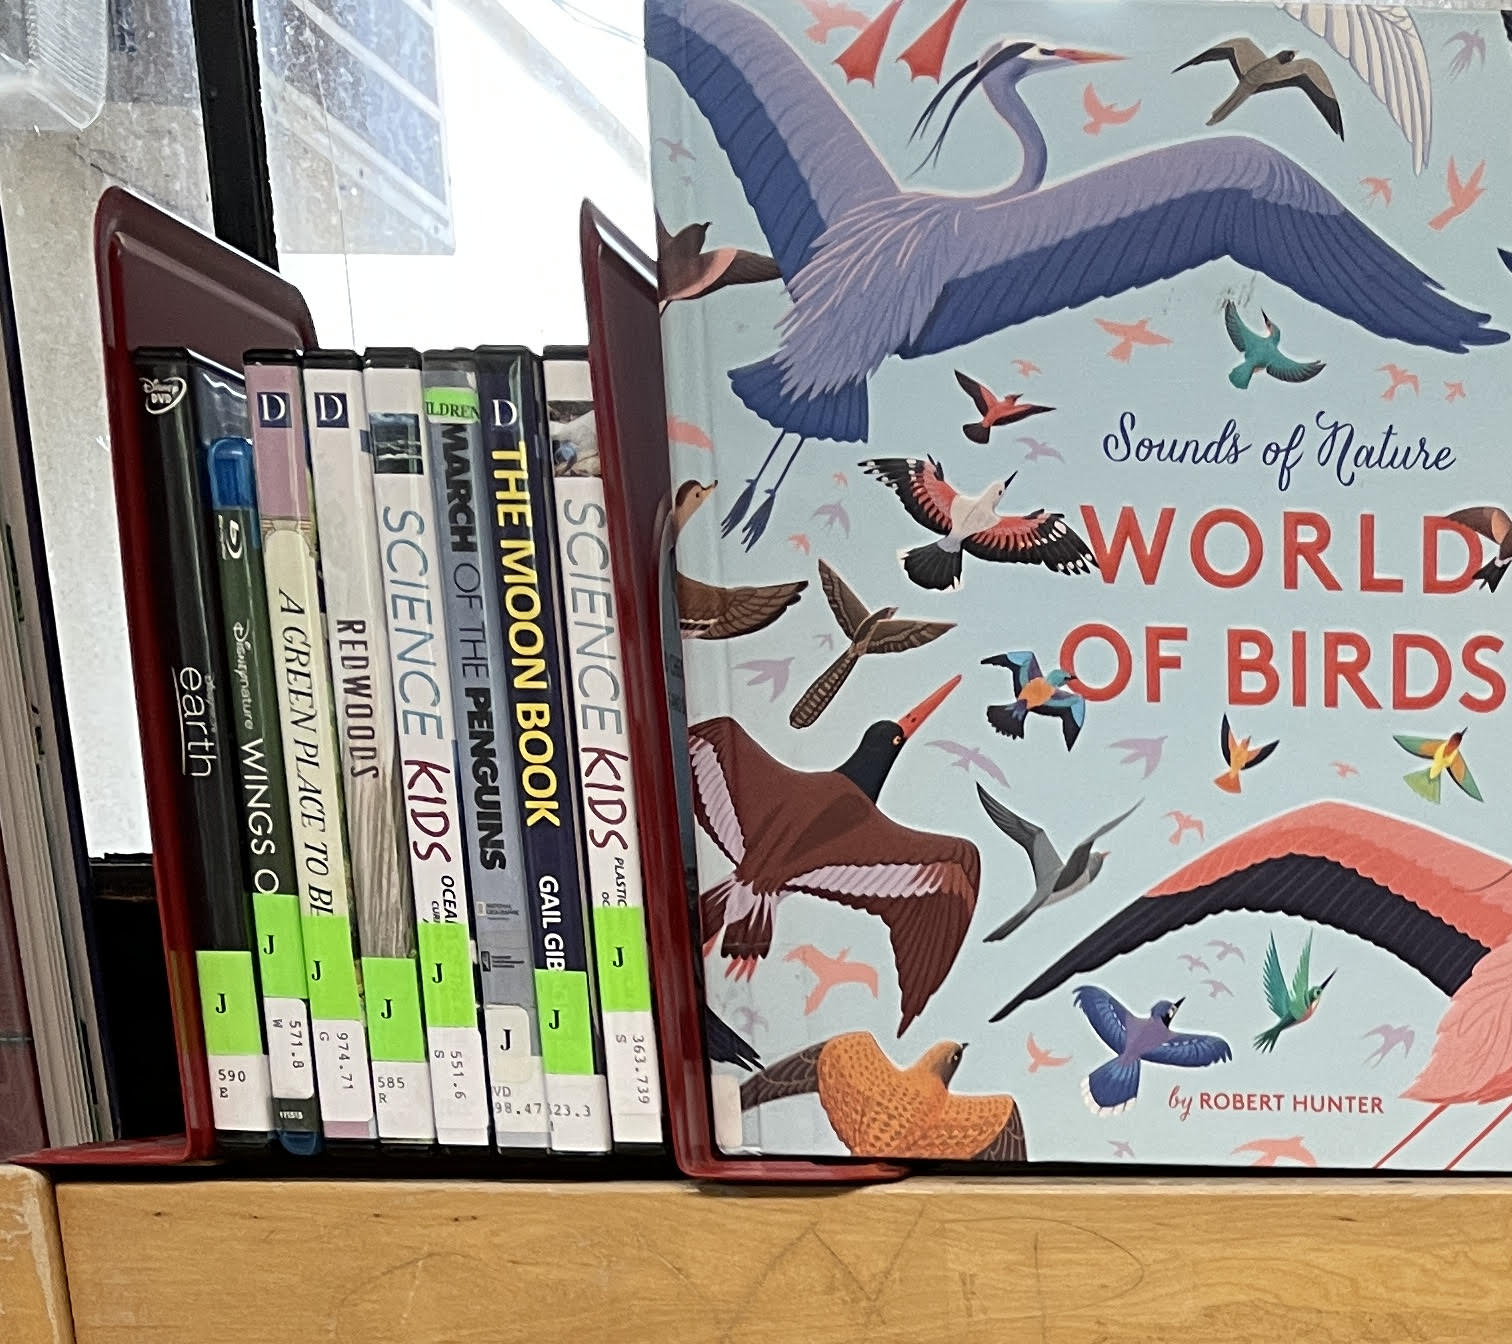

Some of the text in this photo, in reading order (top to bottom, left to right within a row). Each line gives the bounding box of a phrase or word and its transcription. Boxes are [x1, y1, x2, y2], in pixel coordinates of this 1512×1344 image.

[1103, 410, 1456, 492] Sounds of Nature
[1080, 505, 1484, 594] WORLD
[278, 587, 305, 615] A
[492, 440, 560, 827] THE MOON BOOK
[282, 627, 317, 733] GREEN
[336, 619, 379, 778] REDWOODS
[383, 506, 452, 863] SCIENCE KIDS
[1059, 623, 1508, 713] OF BIRDS
[179, 667, 215, 777] earth
[240, 738, 276, 855] WINGS
[294, 739, 327, 832] PLACE
[304, 843, 330, 876] TO
[218, 1069, 246, 1083] 590
[291, 1019, 304, 1068] 571.8
[337, 1033, 353, 1090] 974.71
[377, 1076, 405, 1090] 585
[1168, 1085, 1385, 1120] by ROBERT HUNTER
